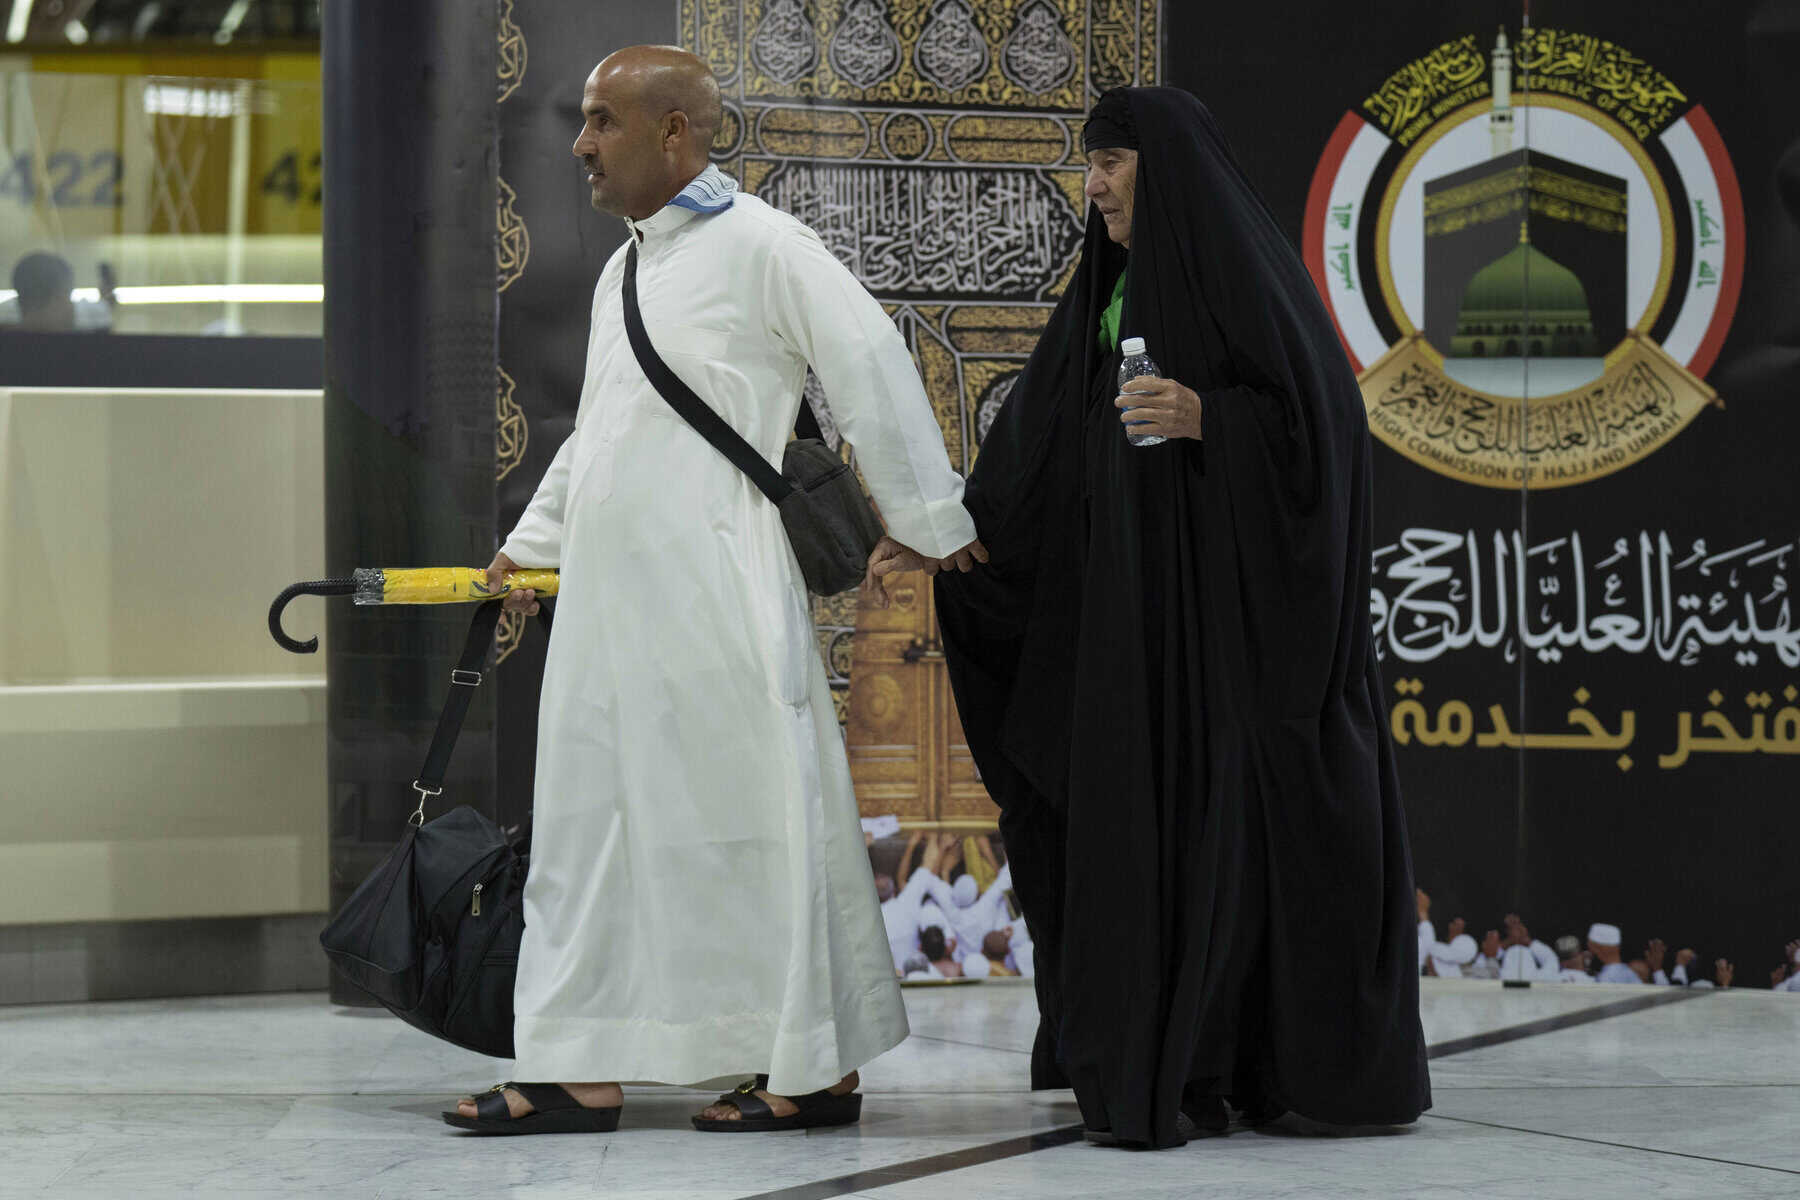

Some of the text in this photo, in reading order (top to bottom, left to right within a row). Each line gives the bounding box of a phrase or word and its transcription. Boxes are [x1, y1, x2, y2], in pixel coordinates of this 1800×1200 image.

[1398, 80, 1489, 147] PRIME MINISTER
[1516, 75, 1650, 140] REPUBLIC OF IRAQ
[1369, 406, 1682, 482] HIGH COMMISSION OF HAJJ AND UMRAH
[1390, 677, 1800, 772] فتخر بخدمة
